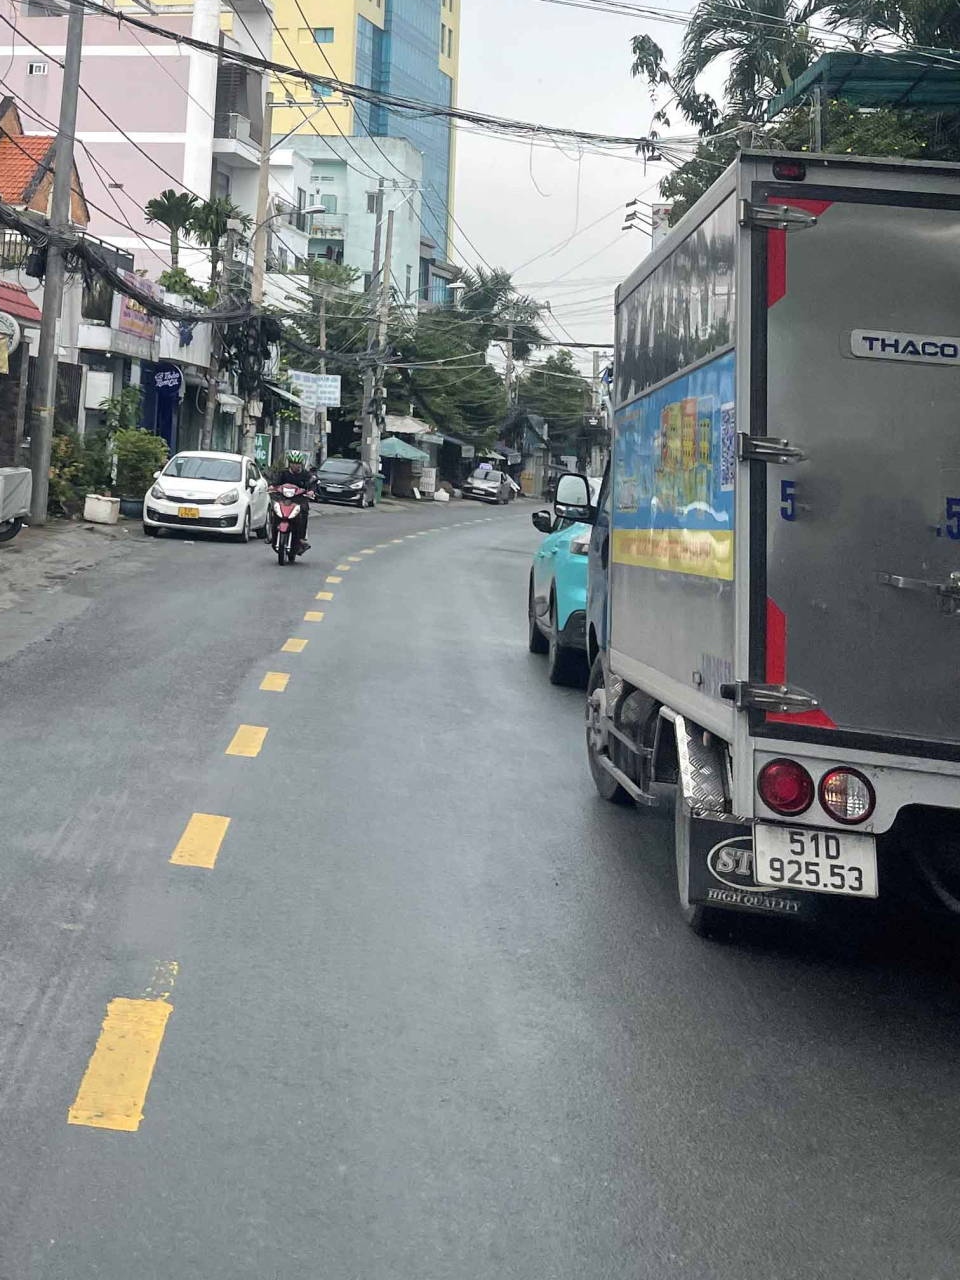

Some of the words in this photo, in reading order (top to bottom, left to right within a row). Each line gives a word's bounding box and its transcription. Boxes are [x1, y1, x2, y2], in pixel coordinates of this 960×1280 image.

[862, 336, 958, 358] THACO
[790, 831, 840, 860] 51D
[769, 857, 863, 892] 925.53
[707, 888, 742, 904] HIGH
[743, 893, 801, 912] QUALITY
